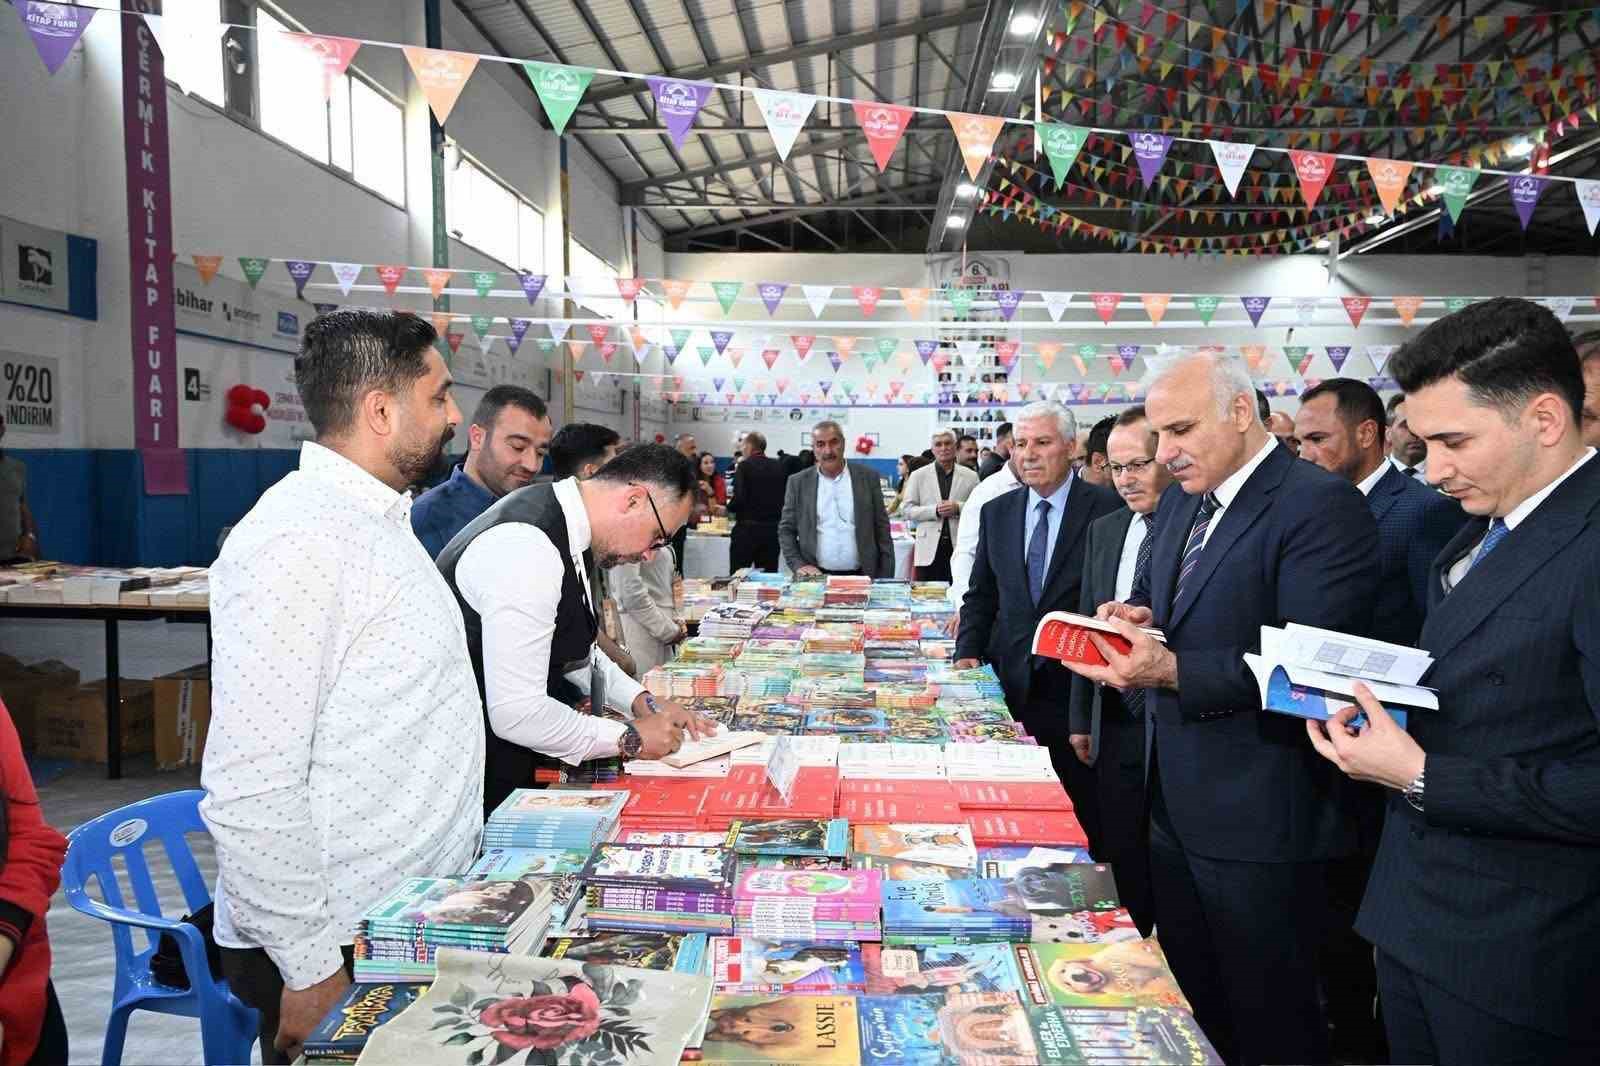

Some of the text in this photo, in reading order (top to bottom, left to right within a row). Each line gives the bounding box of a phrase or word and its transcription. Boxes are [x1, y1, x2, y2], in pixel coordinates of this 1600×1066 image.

[135, 26, 155, 174] ÇERMİK
[142, 189, 160, 307] KİTAP
[176, 287, 214, 313] bihar
[4, 361, 53, 405] %20
[148, 325, 164, 442] FUARI
[4, 404, 53, 428] İNDİRİM
[816, 1002, 837, 1049] LASSIE
[1039, 1029, 1062, 1059] ELMER
[1045, 1010, 1071, 1048] EJDERHA
